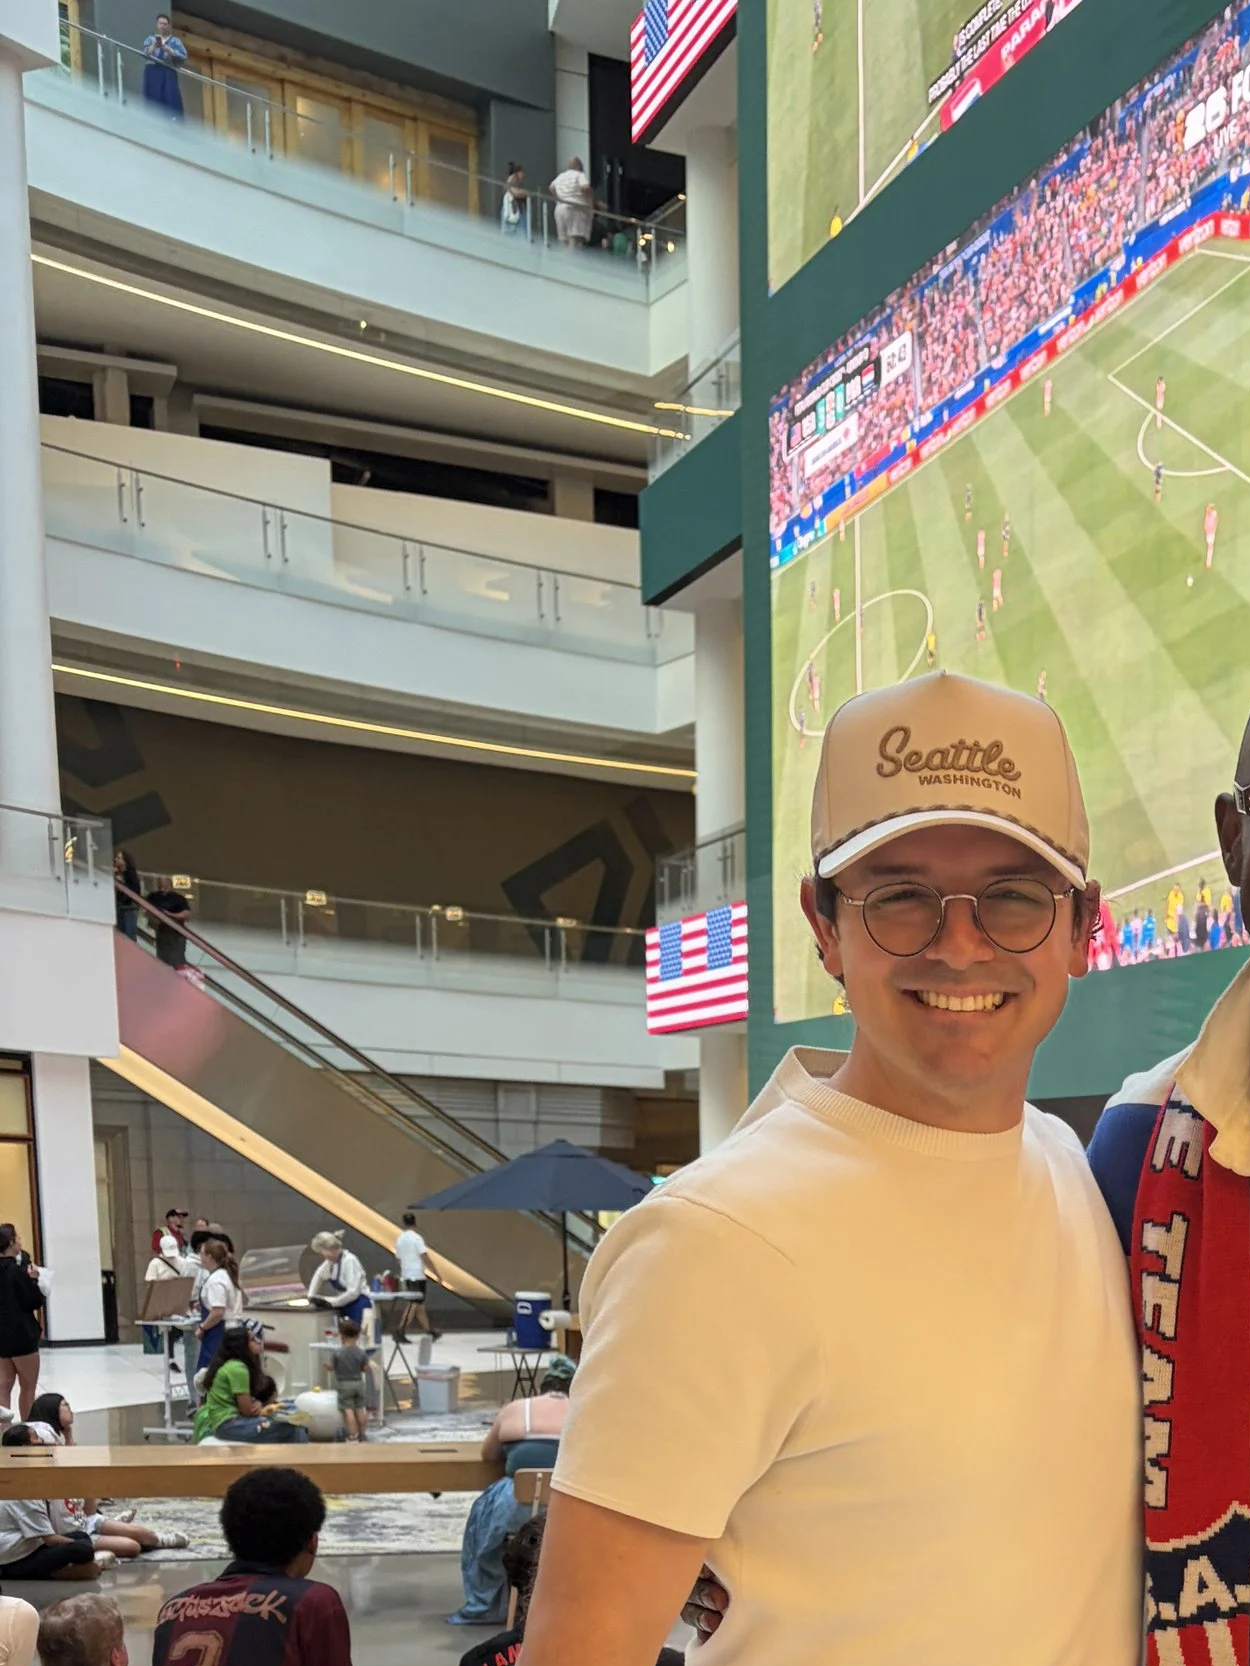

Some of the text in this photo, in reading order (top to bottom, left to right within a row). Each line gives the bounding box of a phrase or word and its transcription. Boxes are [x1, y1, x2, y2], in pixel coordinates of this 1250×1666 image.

[1183, 86, 1227, 151] 26
[876, 725, 1022, 782] Seattle
[918, 773, 1022, 800] WASHINGTON
